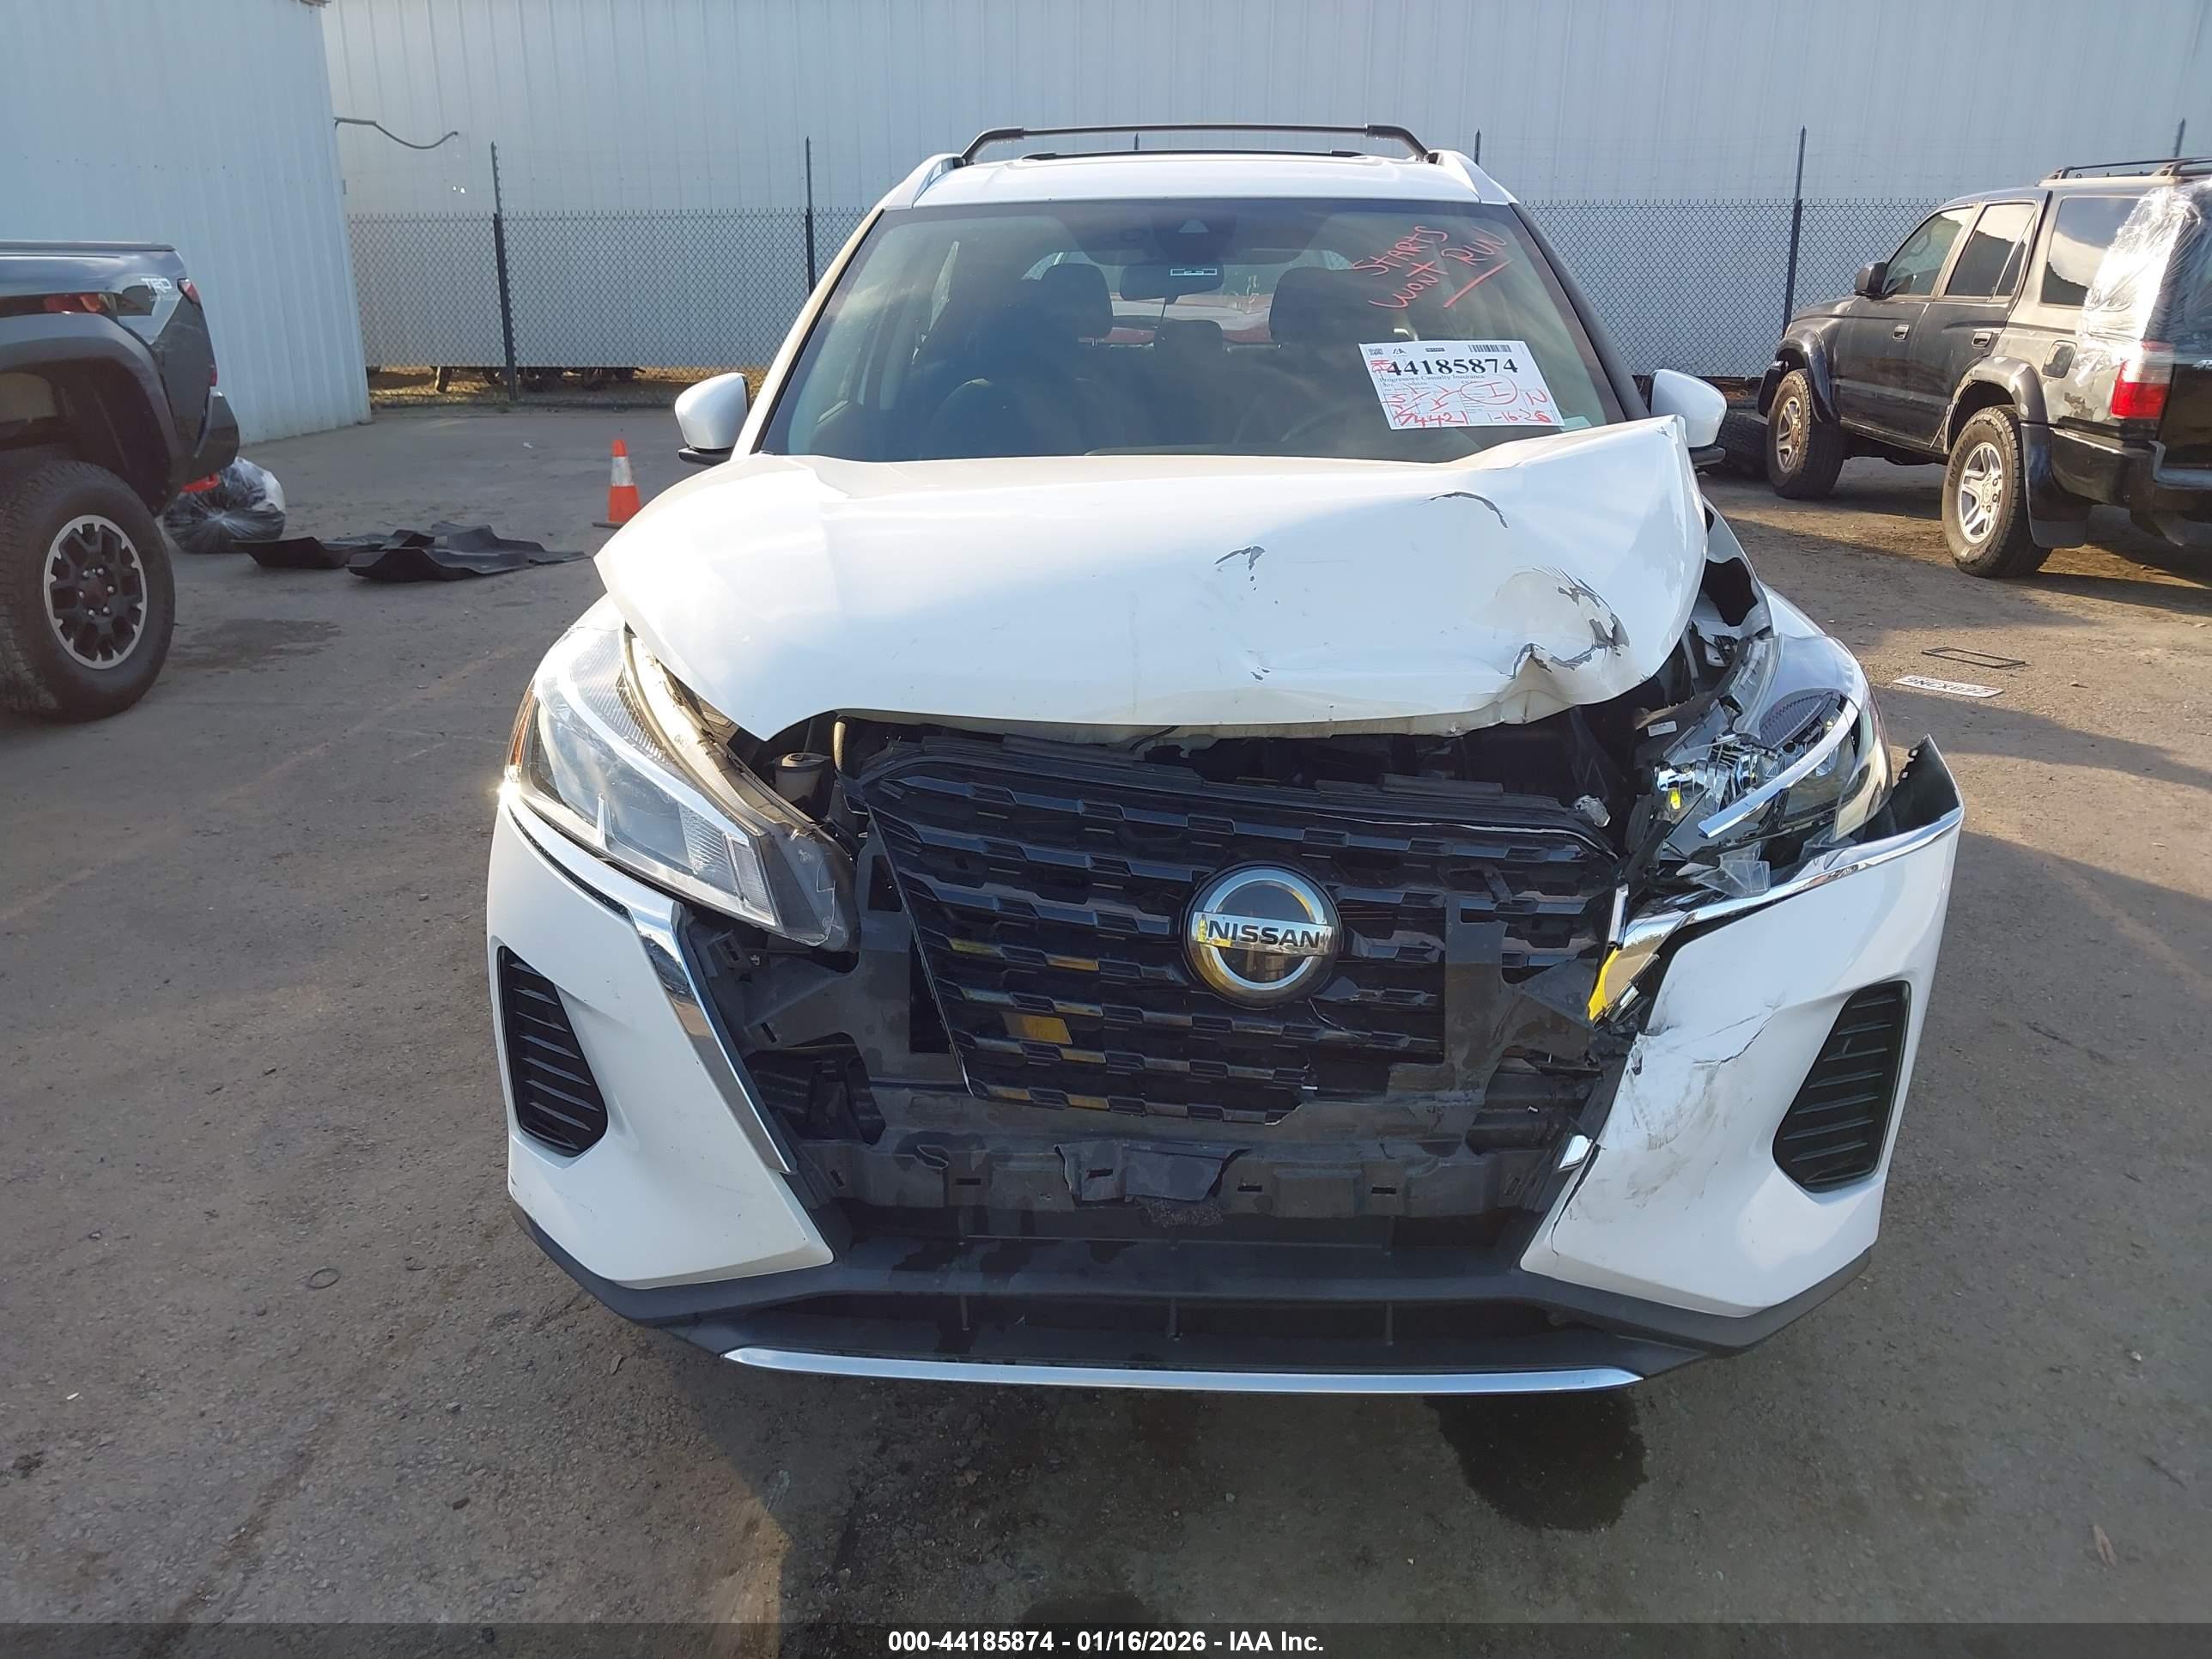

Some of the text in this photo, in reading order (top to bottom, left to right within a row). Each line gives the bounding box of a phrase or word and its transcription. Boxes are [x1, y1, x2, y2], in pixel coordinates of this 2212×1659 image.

[141, 277, 173, 294] TRD
[1387, 358, 1518, 376] 44185874
[1208, 920, 1320, 949] NISSAN
